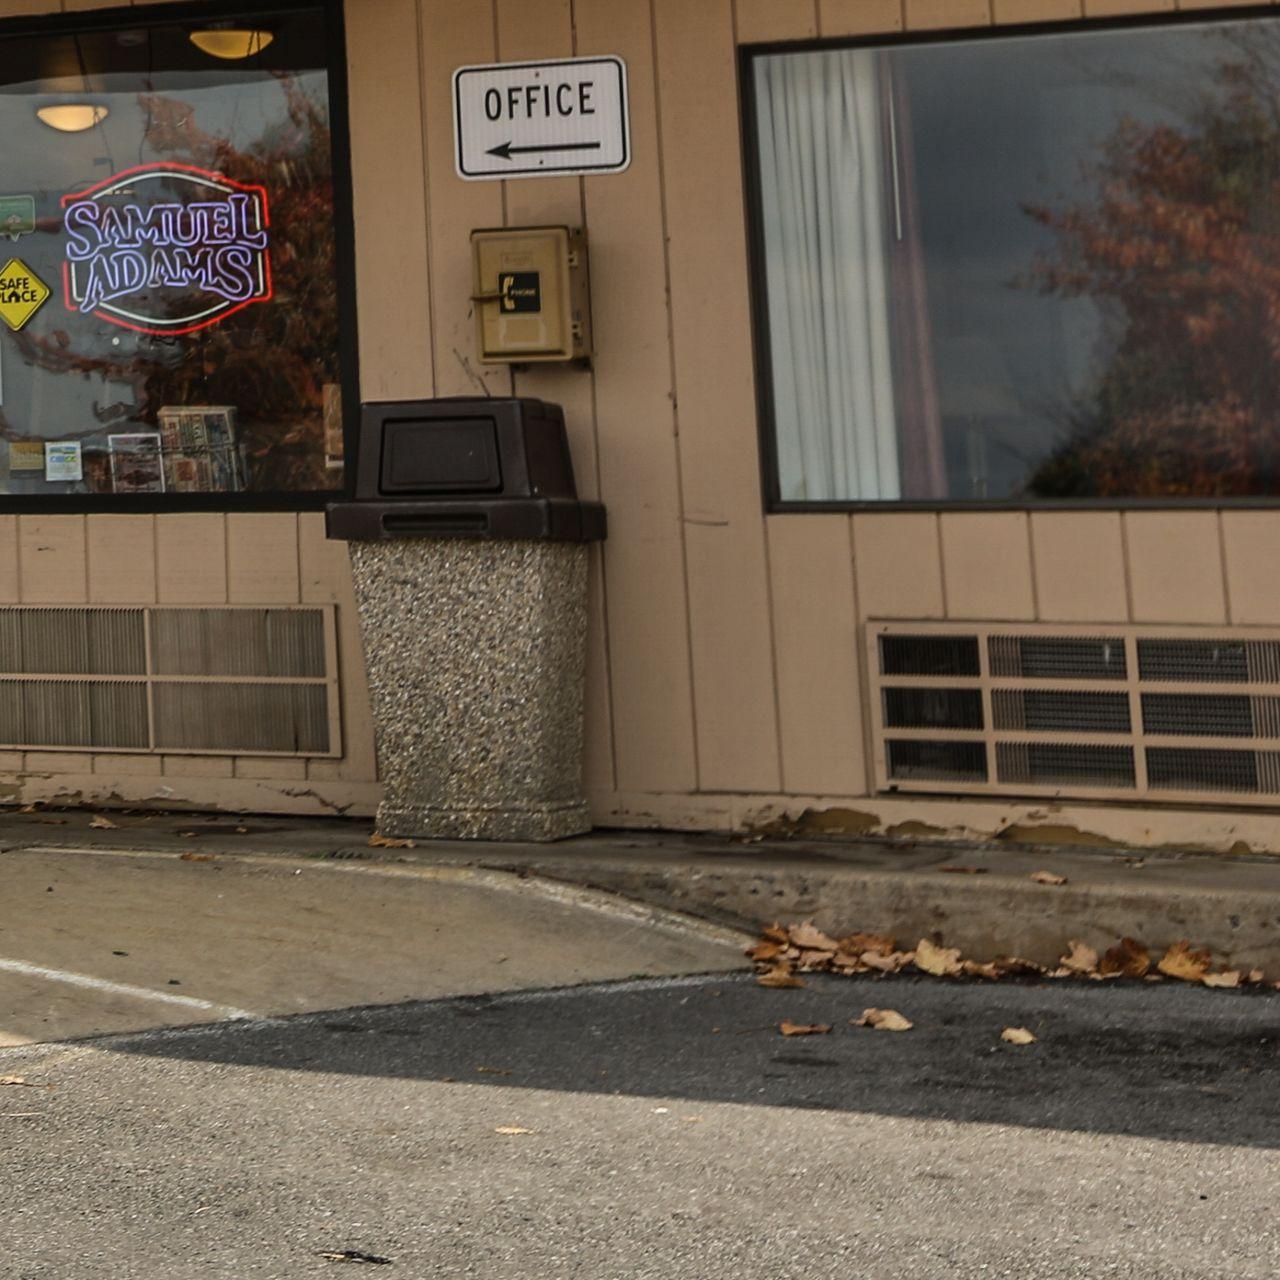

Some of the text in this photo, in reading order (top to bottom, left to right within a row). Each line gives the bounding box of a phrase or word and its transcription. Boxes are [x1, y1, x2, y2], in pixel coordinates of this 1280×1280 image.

[484, 81, 596, 121] OFFICE
[64, 193, 268, 261] SAMUEL
[0, 277, 30, 291] SAFE
[79, 245, 254, 313] ADAMS
